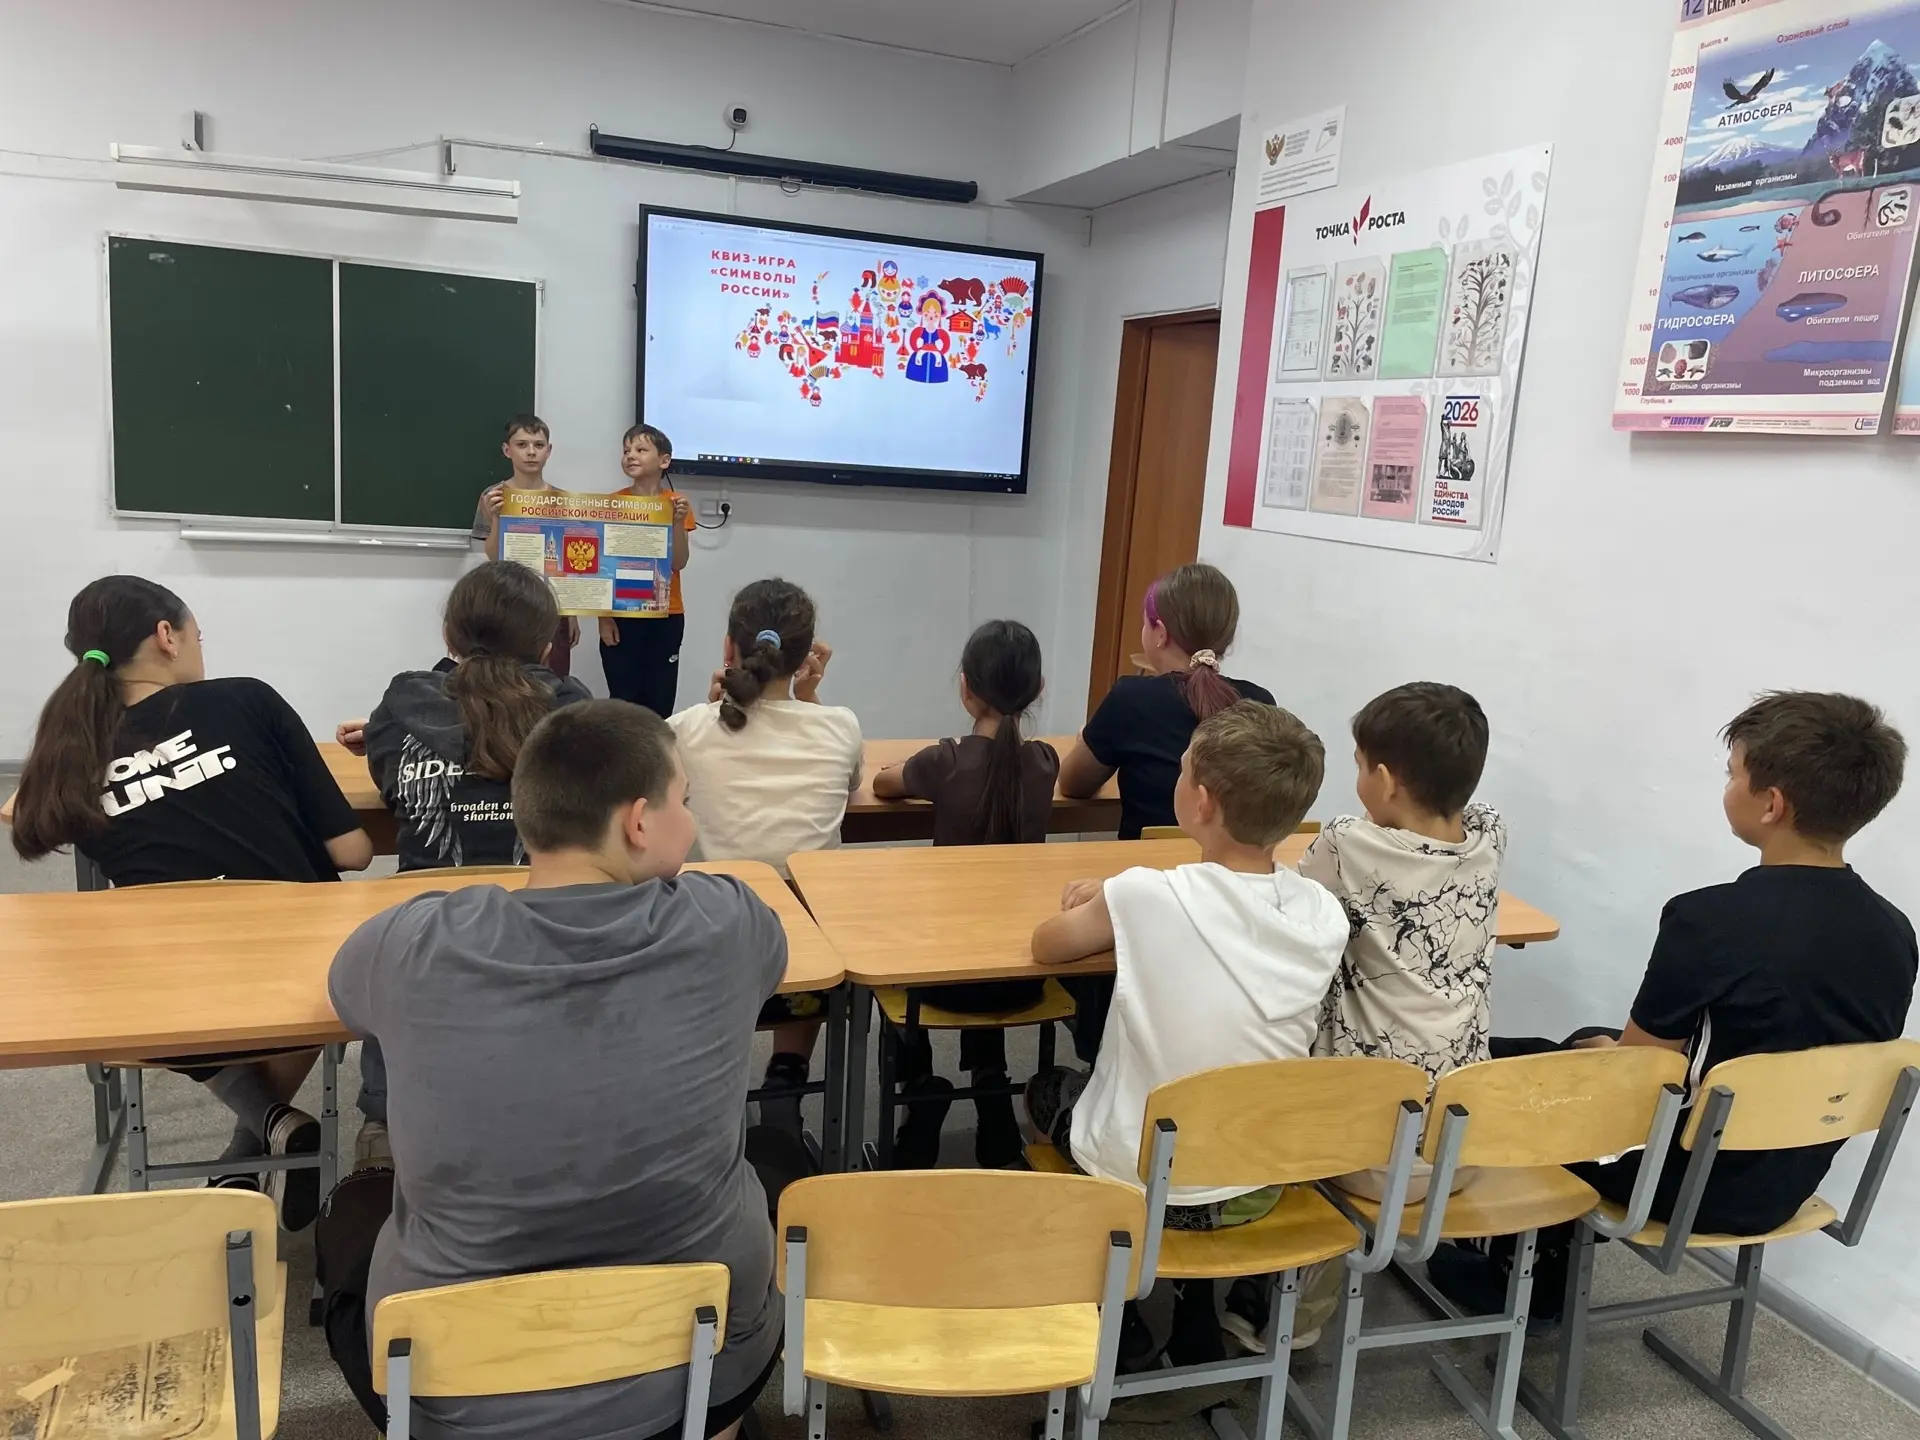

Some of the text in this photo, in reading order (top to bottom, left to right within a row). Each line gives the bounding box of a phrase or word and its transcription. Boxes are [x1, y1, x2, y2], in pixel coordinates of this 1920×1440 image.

[1682, 0, 1702, 16] 12
[1777, 18, 1850, 43] Озоновый слой
[1671, 66, 1694, 77] 22000
[1673, 81, 1692, 91] 8000
[1718, 102, 1793, 127] АТМОСФЕРА
[1664, 137, 1683, 146] 4000
[1663, 174, 1677, 183] 100
[1715, 172, 1798, 193] Наземные организмы
[1315, 211, 1405, 240] ТОЧКА РОСТА
[711, 250, 797, 269] КВИЗ-ИГРА
[710, 266, 796, 285] «СИМВОЛЫ
[1797, 264, 1880, 284] ЛИТОСФЕРА
[721, 283, 790, 300] РОССИИ»
[1657, 313, 1736, 330] ГИДРОСФЕРА
[1806, 316, 1850, 326] Обитатели
[1639, 324, 1651, 332] 100
[1630, 357, 1646, 365] 1000
[1803, 367, 1872, 377] Микроорганизмы
[1669, 382, 1741, 391] Донные организмы
[1819, 377, 1881, 387] подземных вод
[1624, 387, 1640, 396] 1000
[1444, 401, 1479, 421] 2026
[1435, 481, 1448, 490] ГОД
[1434, 489, 1469, 500] ЕДИНСТВА
[510, 493, 663, 511] ГОСУДАРСТВЕННЫЕ СИМВОЛЫ
[1433, 499, 1465, 509] НАРОДОВ
[590, 510, 649, 522] ФЕДЕРАЦИИ
[1432, 507, 1460, 516] РОССИИ
[102, 729, 198, 788] OME
[402, 759, 477, 784] SIDE
[450, 800, 499, 813] broaden
